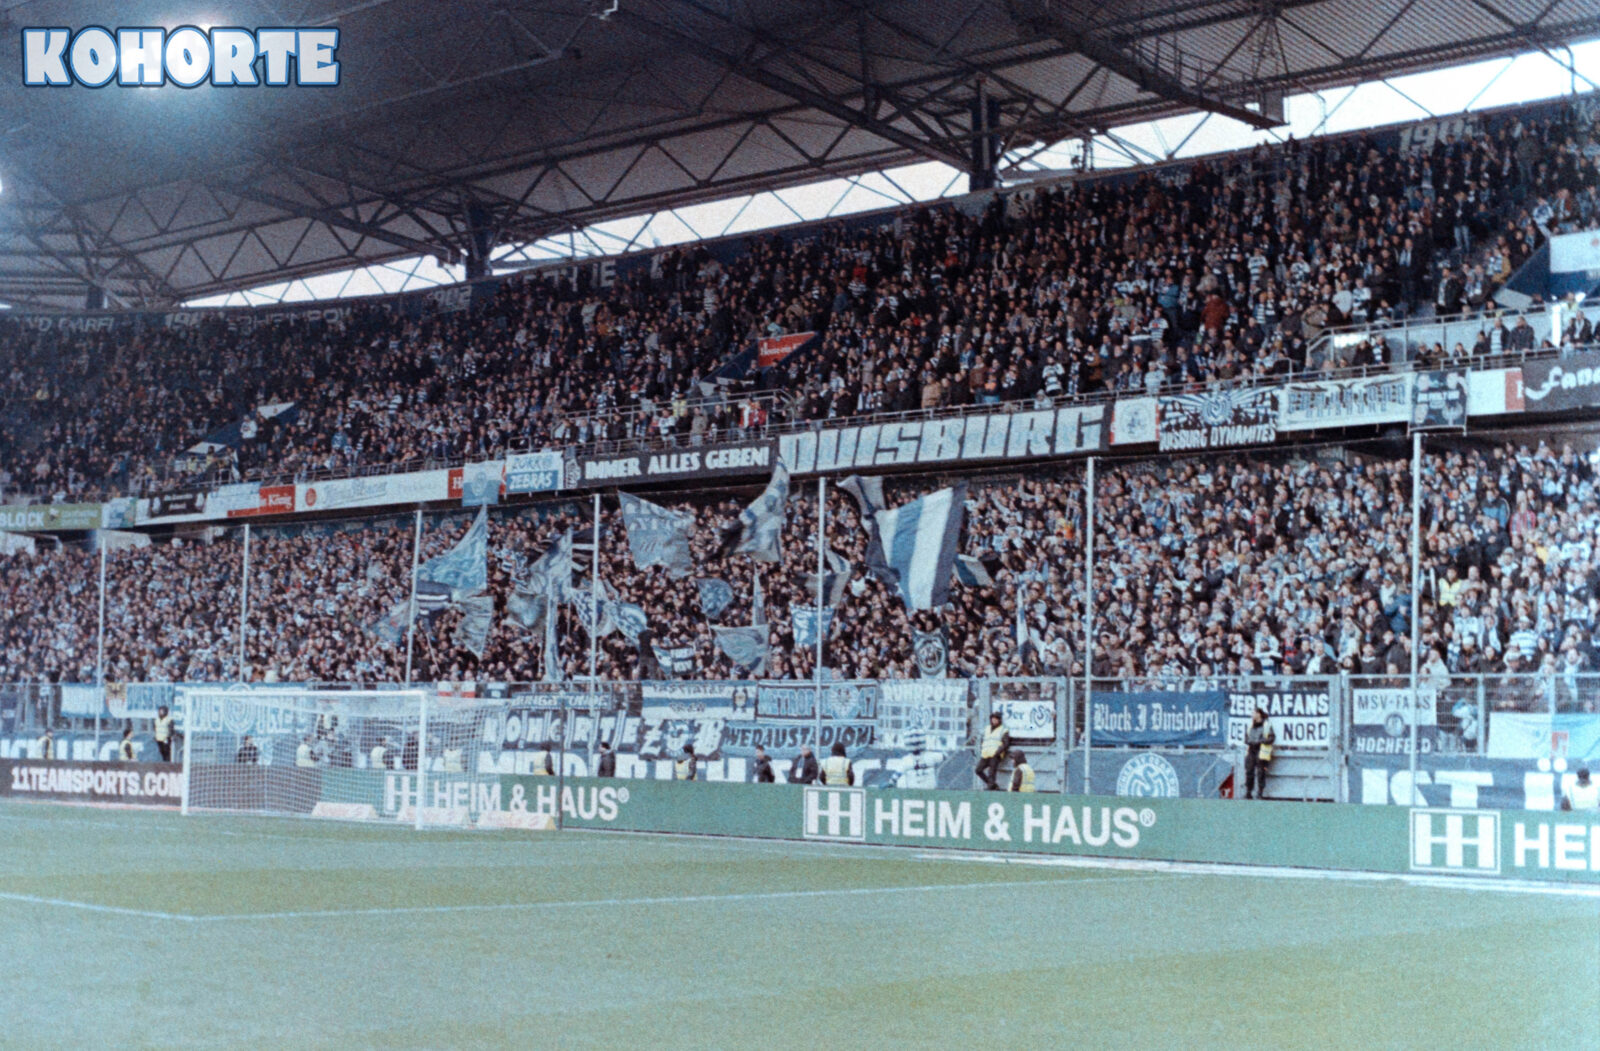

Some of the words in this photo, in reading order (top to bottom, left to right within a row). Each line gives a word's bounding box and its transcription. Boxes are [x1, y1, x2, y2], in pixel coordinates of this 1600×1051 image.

[778, 403, 1106, 474] DUISBURG
[1210, 422, 1276, 447] DYNAMITES
[584, 456, 642, 480] IMMER
[647, 452, 700, 475] ALLES
[705, 446, 770, 470] GEBEN!
[508, 471, 554, 491] ZEBRAS
[1229, 693, 1329, 716] ZEBRAFANS
[1093, 703, 1132, 732] Block
[1151, 702, 1219, 736] Duisburg
[1283, 722, 1328, 741] NORD
[1356, 737, 1432, 754] HOCHFED
[511, 783, 528, 813] &
[874, 798, 971, 839] HEIM
[983, 803, 1011, 842] &
